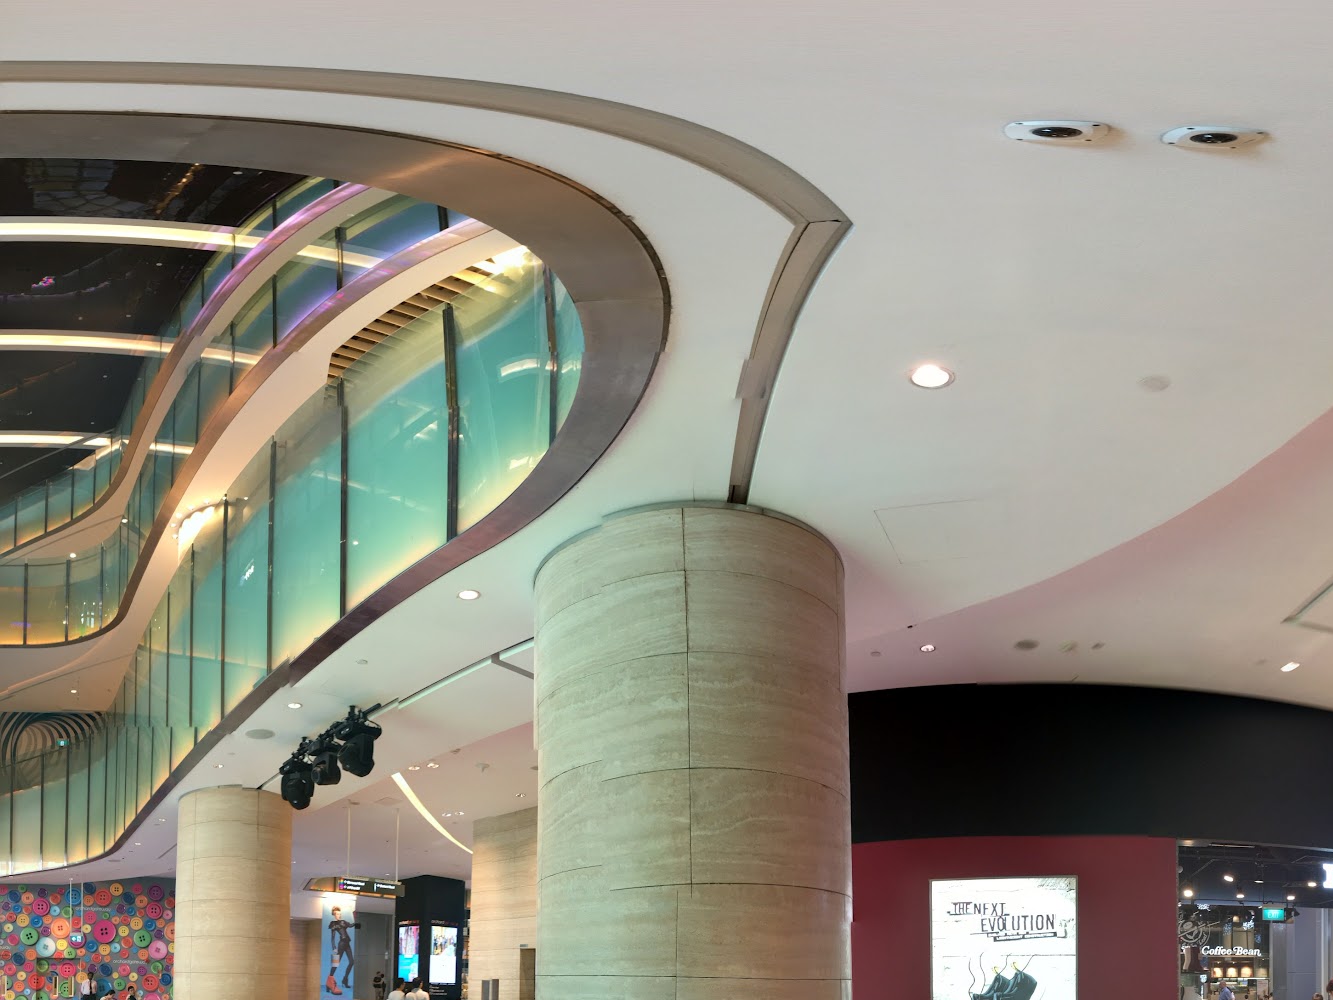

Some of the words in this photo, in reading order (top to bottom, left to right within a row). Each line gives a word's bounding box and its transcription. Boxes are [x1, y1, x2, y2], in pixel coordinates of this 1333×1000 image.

[981, 914, 1055, 932] EVOLUTION
[1201, 945, 1232, 956] Coffee
[1233, 946, 1261, 957] Bean
